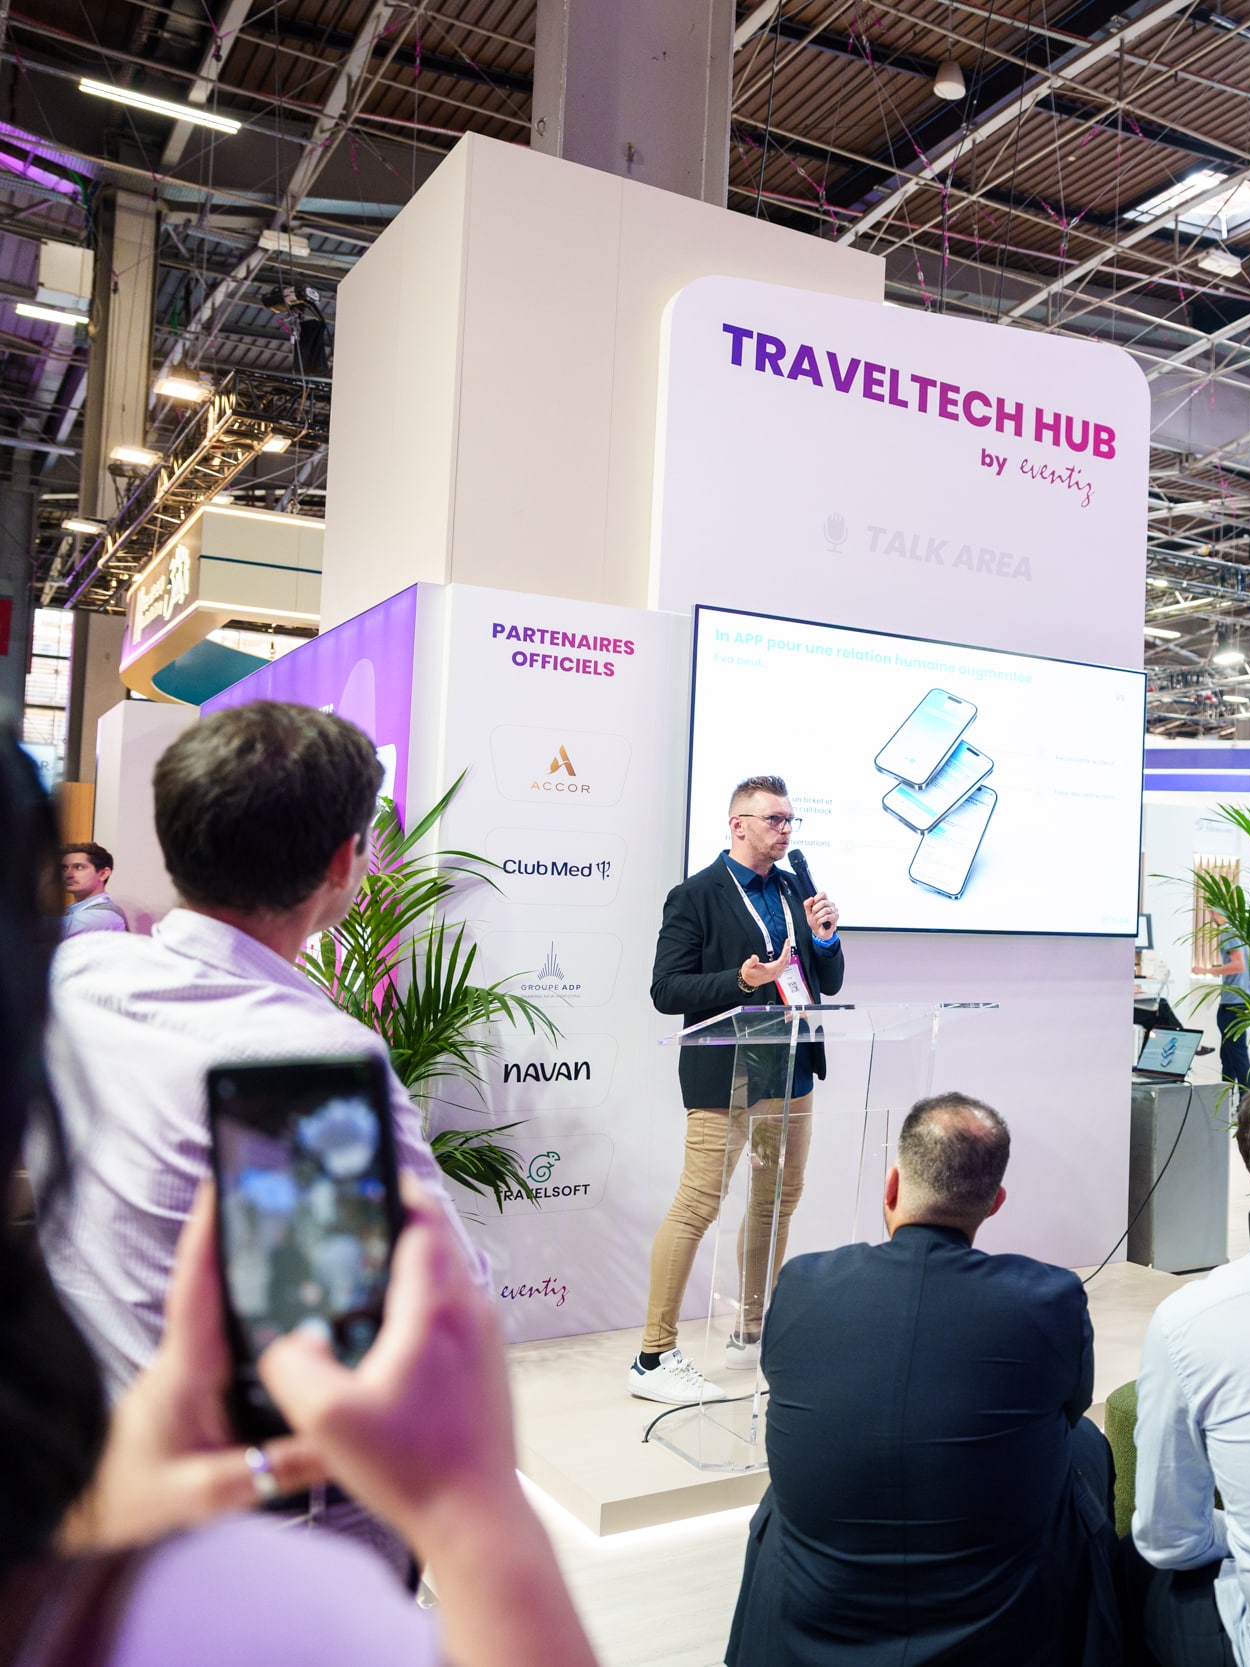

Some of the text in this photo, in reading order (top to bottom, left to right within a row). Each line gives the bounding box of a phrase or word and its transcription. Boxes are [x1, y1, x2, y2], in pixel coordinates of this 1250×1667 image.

[721, 322, 1117, 460] TRAVELTECH HUB
[980, 448, 1096, 507] by eventiz
[866, 524, 1033, 582] TALK AREA
[492, 623, 636, 656] PARTENAIRES
[511, 650, 616, 678] OFFICIELS
[715, 628, 1033, 685] In APP pour une relation humaine augmentée
[529, 780, 591, 795] ACCOR
[502, 858, 593, 878] Club Med
[500, 1276, 570, 1307] eventiz
